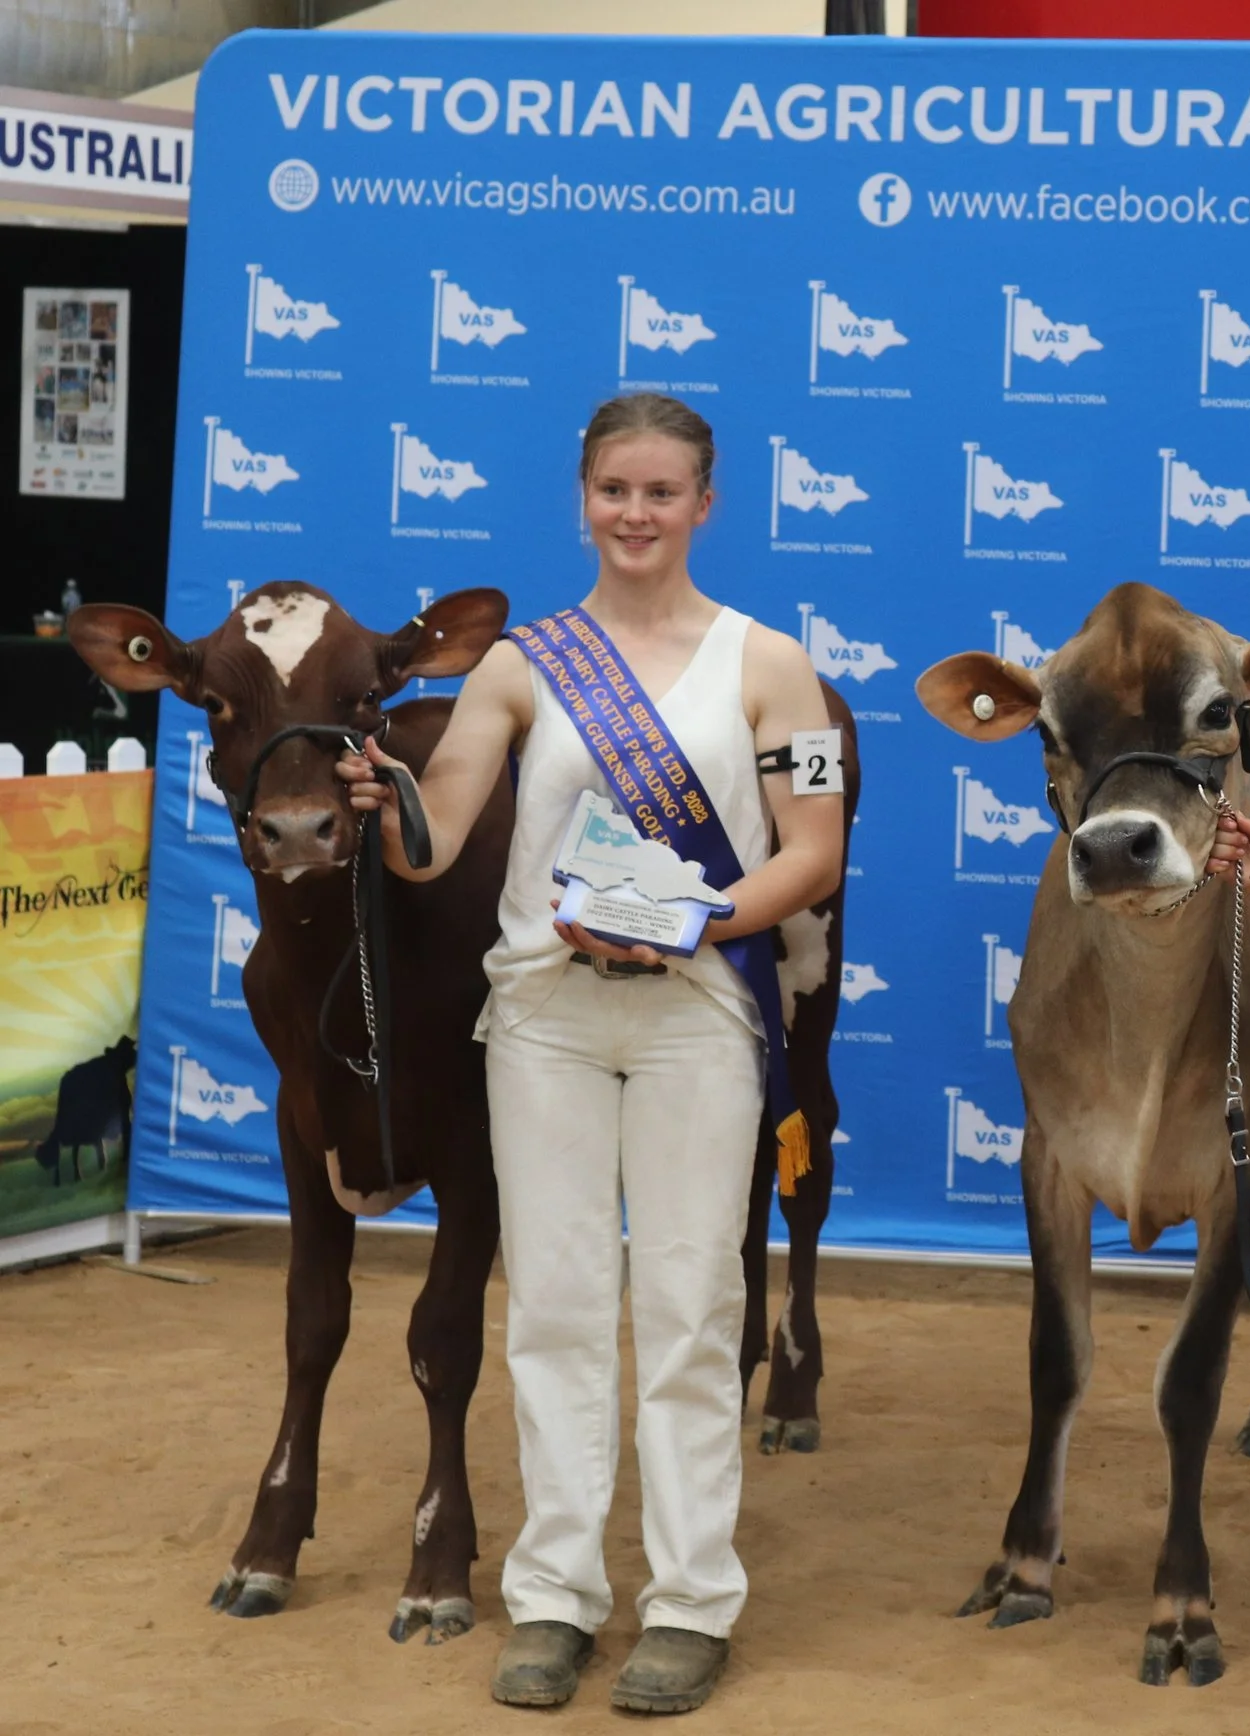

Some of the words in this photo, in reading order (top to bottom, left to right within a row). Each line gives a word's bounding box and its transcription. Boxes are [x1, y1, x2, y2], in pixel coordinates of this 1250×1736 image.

[269, 74, 691, 138] VICTORIAN
[0, 118, 184, 186] USTRALI
[332, 175, 795, 216] www.vicagshows.com.au
[273, 307, 309, 321] VAS
[459, 312, 494, 327] VAS
[647, 318, 683, 333] VAS
[838, 324, 875, 338] VAS
[1032, 329, 1069, 344] VAS
[245, 368, 293, 379] SHOWING
[295, 369, 342, 380] VICTORIA
[431, 374, 479, 385] SHOWING
[482, 375, 529, 386] VICTORIA
[619, 381, 668, 392] SHOWING
[670, 382, 719, 393] VICTORIA
[810, 386, 859, 397] SHOWING
[862, 387, 911, 398] VICTORIA
[1004, 392, 1054, 403] SHOWING
[1057, 393, 1106, 404] VICTORIA
[231, 459, 267, 473] VAS
[419, 466, 455, 480] VAS
[799, 480, 835, 494] VAS
[992, 486, 1030, 501] VAS
[1189, 493, 1227, 508] VAS
[203, 520, 252, 531] SHOWING
[255, 521, 302, 532] VICTORIA
[391, 527, 440, 539] SHOWING
[442, 528, 490, 540] VICTORIA
[771, 541, 820, 553] SHOWING
[823, 542, 872, 554] VICTORIA
[964, 549, 1015, 560] SHOWING
[1018, 550, 1067, 561] VICTORIA
[1160, 556, 1211, 567] SHOWING
[827, 647, 864, 662] VAS
[1022, 655, 1046, 669] VA
[563, 615, 637, 706] AGRICULTURAL
[628, 702, 669, 755] SHOWS
[659, 752, 688, 792] LTD.
[683, 790, 709, 825] 2023
[537, 651, 595, 725] BLENCOWE
[585, 722, 644, 804] GUERNSEY
[564, 646, 600, 687] DAIRY
[591, 687, 633, 742] CATTLE
[623, 737, 680, 820] PARADING
[807, 754, 828, 787] 2
[982, 811, 1020, 826] VAS
[955, 872, 1005, 884] SHOWING
[1008, 874, 1040, 886] VICTO
[0, 884, 46, 929] The
[52, 874, 109, 911] Next
[844, 1033, 893, 1044] VICTORIA
[199, 1088, 236, 1105] VAS
[975, 1131, 1012, 1146] VAS
[169, 1149, 220, 1162] SHOWING
[221, 1152, 270, 1165] VICTORIA
